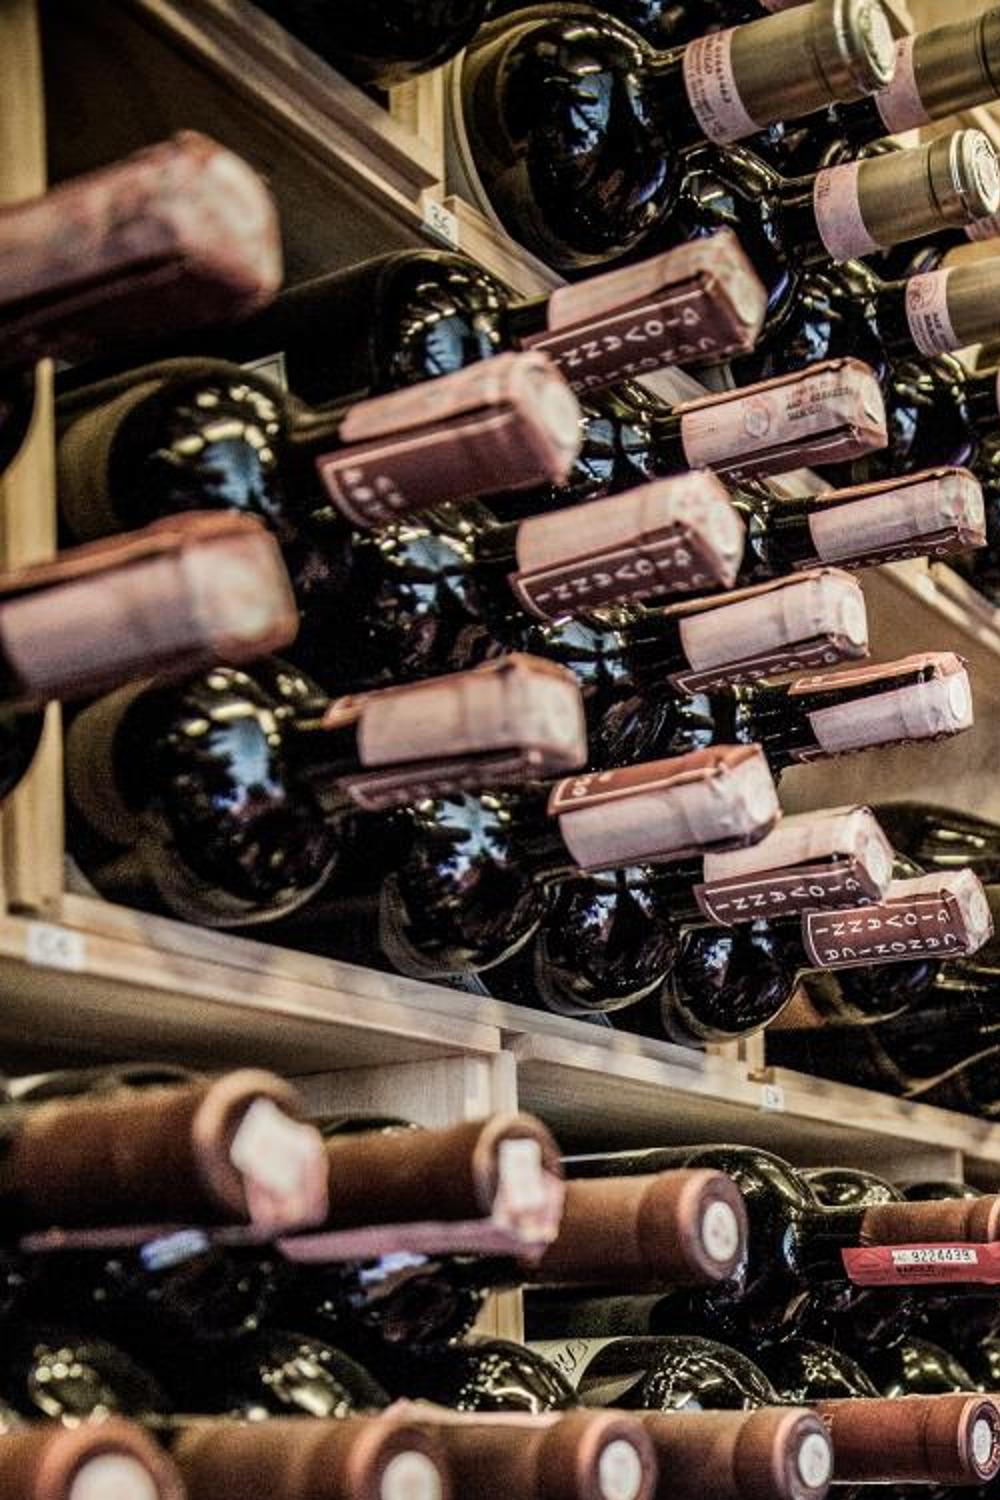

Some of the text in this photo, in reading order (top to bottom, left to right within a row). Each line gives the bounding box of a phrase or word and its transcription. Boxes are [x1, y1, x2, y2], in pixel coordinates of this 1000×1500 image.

[715, 877, 860, 910] GIOVANNI
[815, 908, 950, 936] GIOVANNI
[824, 933, 957, 960] CANONICA
